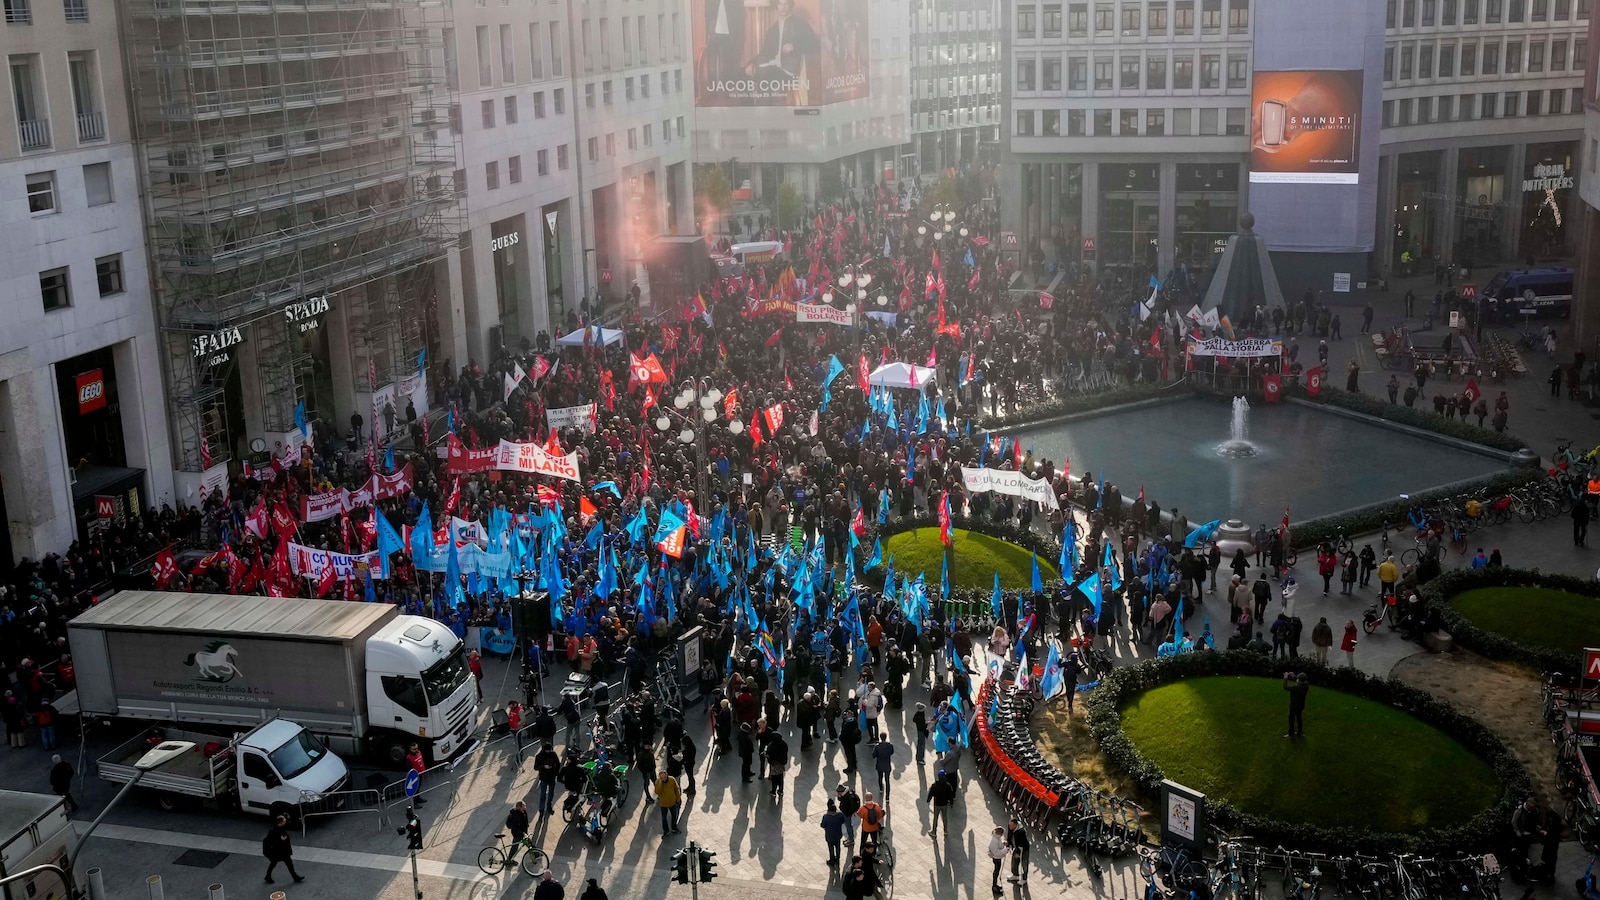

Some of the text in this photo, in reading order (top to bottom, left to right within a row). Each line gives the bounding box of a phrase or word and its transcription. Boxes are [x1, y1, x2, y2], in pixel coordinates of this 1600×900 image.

[706, 76, 810, 92] JACOB COHËN
[825, 77, 845, 90] JACOB
[1290, 116, 1351, 124] 5 MINUTI
[1533, 162, 1564, 178] URBAN
[1522, 176, 1574, 192] OUTFITTERS
[491, 231, 519, 252] GUESS
[284, 295, 329, 323] SPADA
[783, 301, 797, 313] MIL
[799, 305, 850, 318] RSU PIRELL
[806, 313, 846, 323] BOLLATE
[299, 319, 319, 333] ROMA
[192, 326, 243, 358] SPADA
[1204, 344, 1264, 352] DALLA STORIA!
[1236, 339, 1271, 347] GUERRA
[80, 381, 103, 404] LEGO
[520, 445, 534, 457] SPI
[519, 457, 577, 478] MILANO
[98, 500, 114, 514] M
[153, 680, 195, 691] Autotrasporti
[196, 684, 224, 694] Regondi
[224, 685, 246, 694] Emilio
[247, 687, 254, 695] &
[254, 687, 262, 695] C.
[160, 690, 184, 698] ABBIAMO
[227, 694, 246, 702] MERCE
